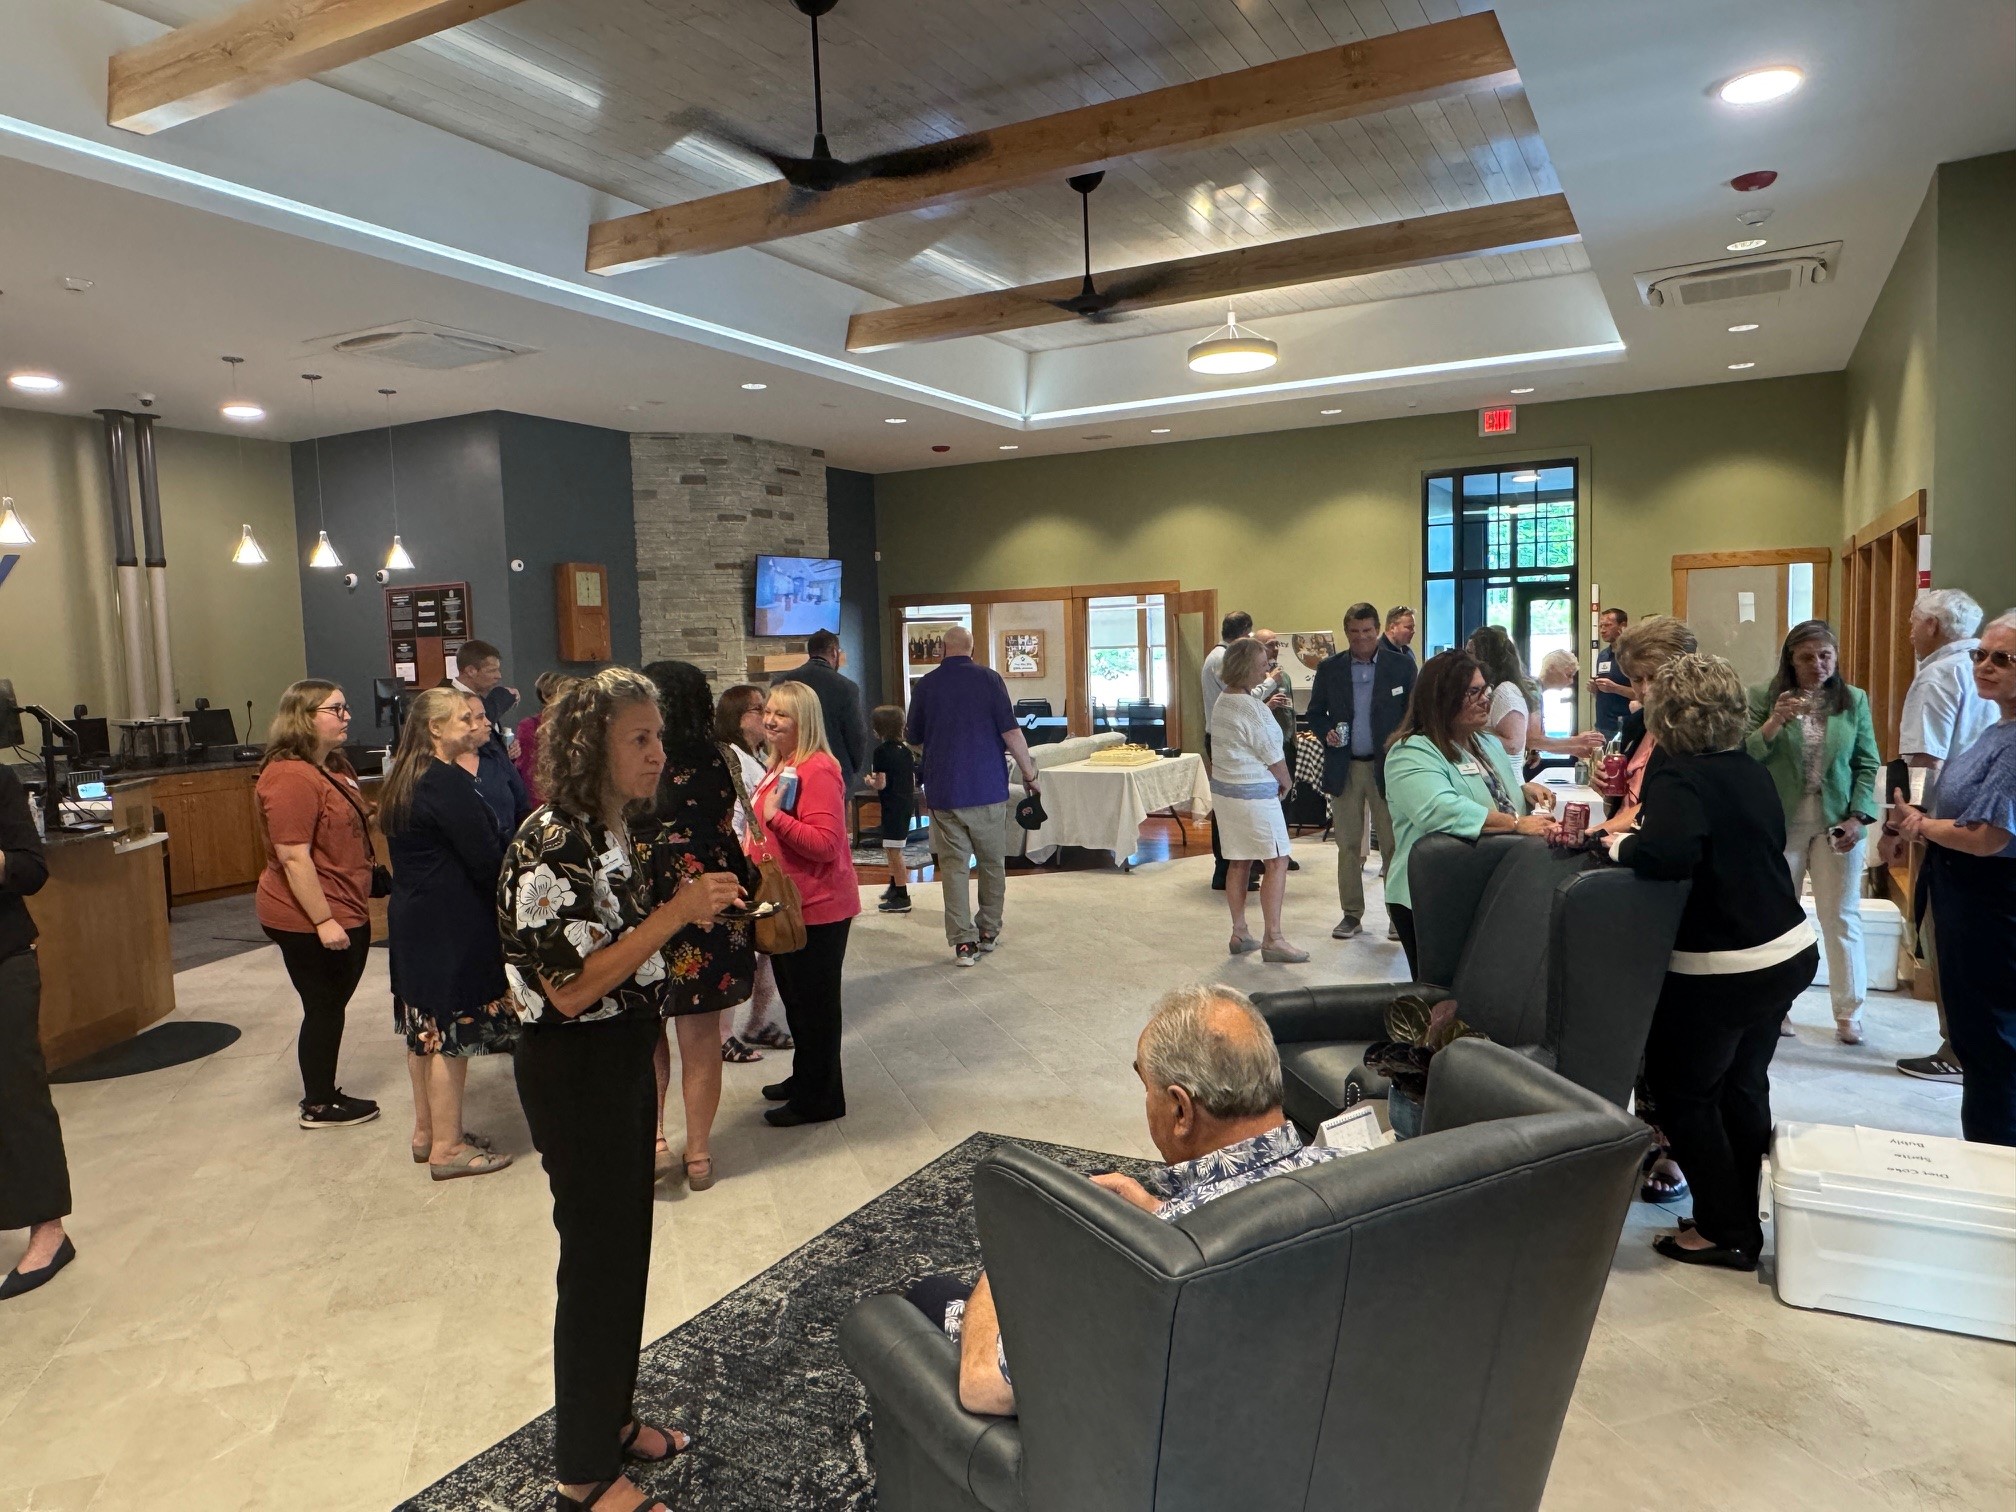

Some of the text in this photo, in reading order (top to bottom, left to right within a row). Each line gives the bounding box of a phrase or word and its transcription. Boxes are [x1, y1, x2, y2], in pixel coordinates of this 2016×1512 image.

[1485, 410, 1512, 432] EXIT
[1887, 1167, 1949, 1178] Diet Coke
